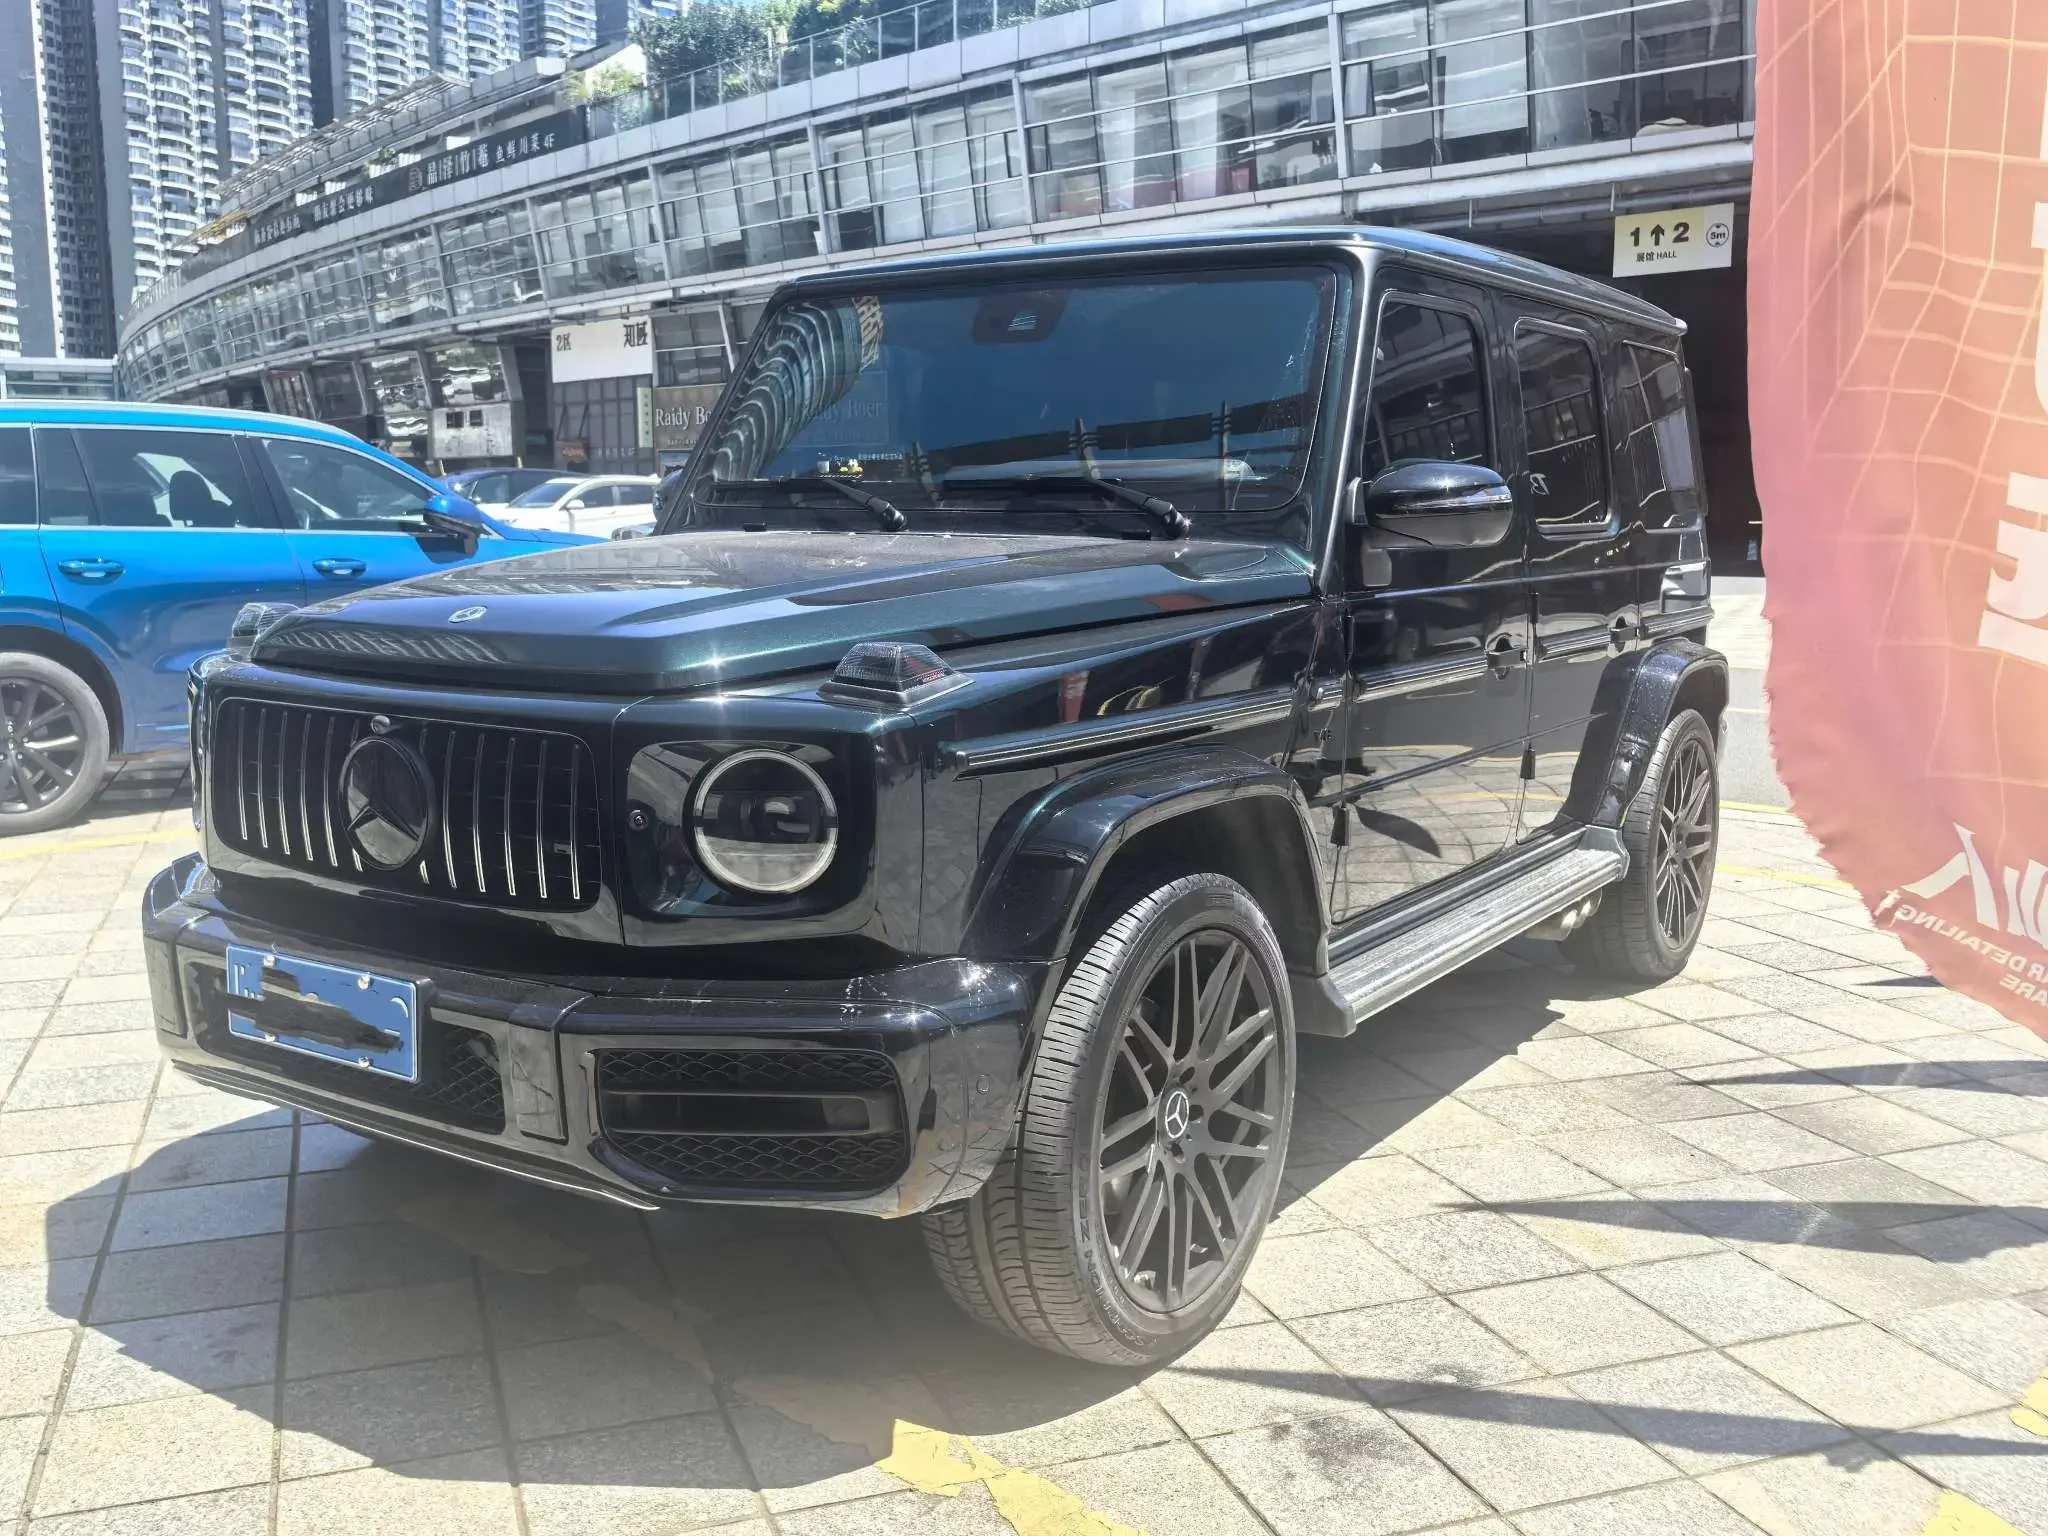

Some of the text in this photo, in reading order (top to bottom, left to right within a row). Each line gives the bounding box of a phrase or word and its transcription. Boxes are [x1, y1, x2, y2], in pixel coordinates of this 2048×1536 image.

[1630, 222, 1690, 247] 1 2
[1710, 231, 1726, 240] 5m
[1636, 251, 1677, 262] 展馆 HALL
[656, 407, 689, 431] Raidy
